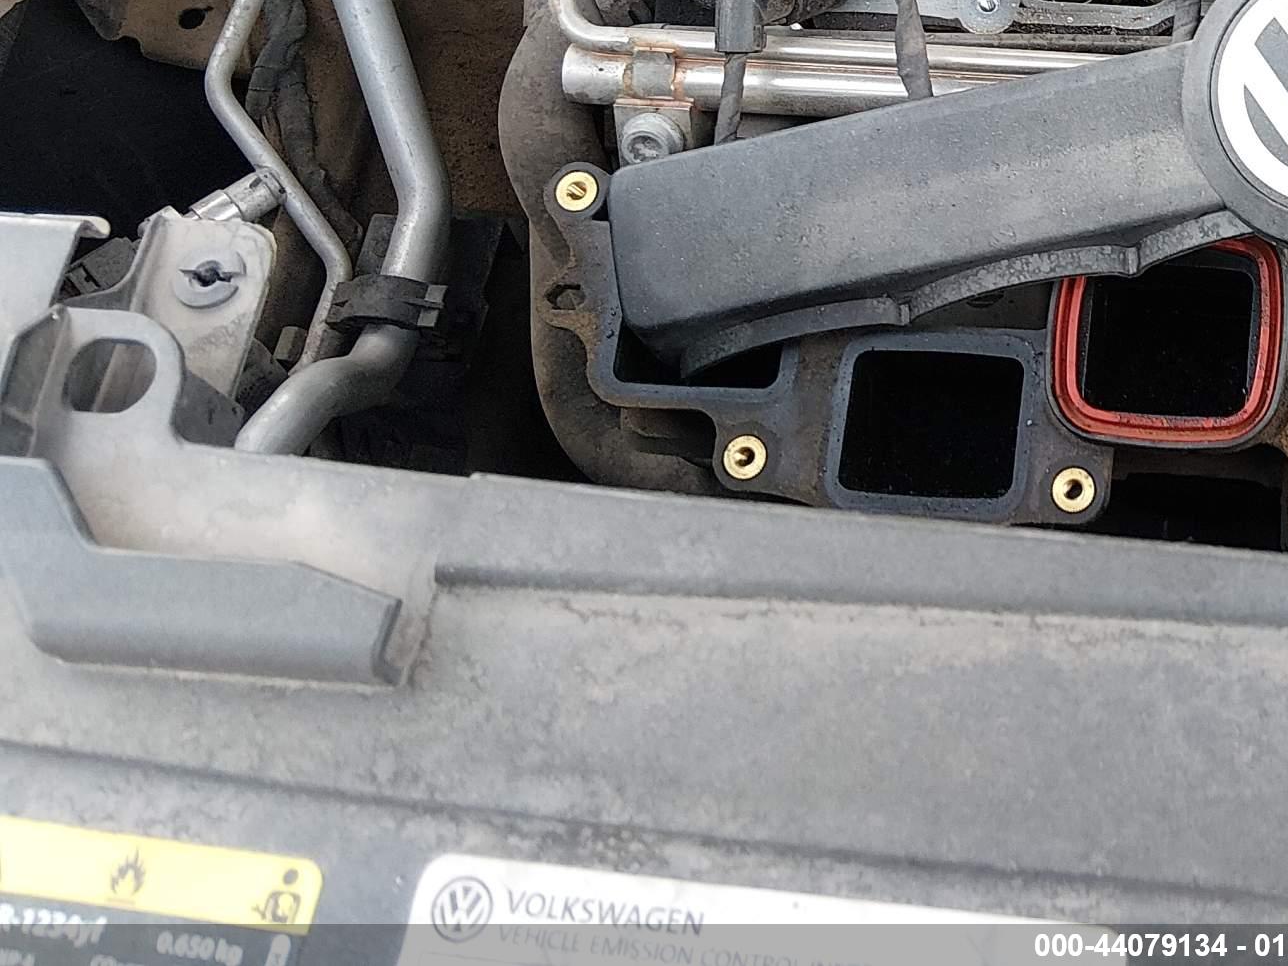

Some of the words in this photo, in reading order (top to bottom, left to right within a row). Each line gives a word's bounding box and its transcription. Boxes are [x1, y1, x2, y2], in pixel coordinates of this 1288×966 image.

[505, 886, 705, 937] VOLKSWAGEN
[214, 936, 244, 966] kg
[498, 927, 580, 953] VEHICLE
[590, 935, 695, 965] EMISSION
